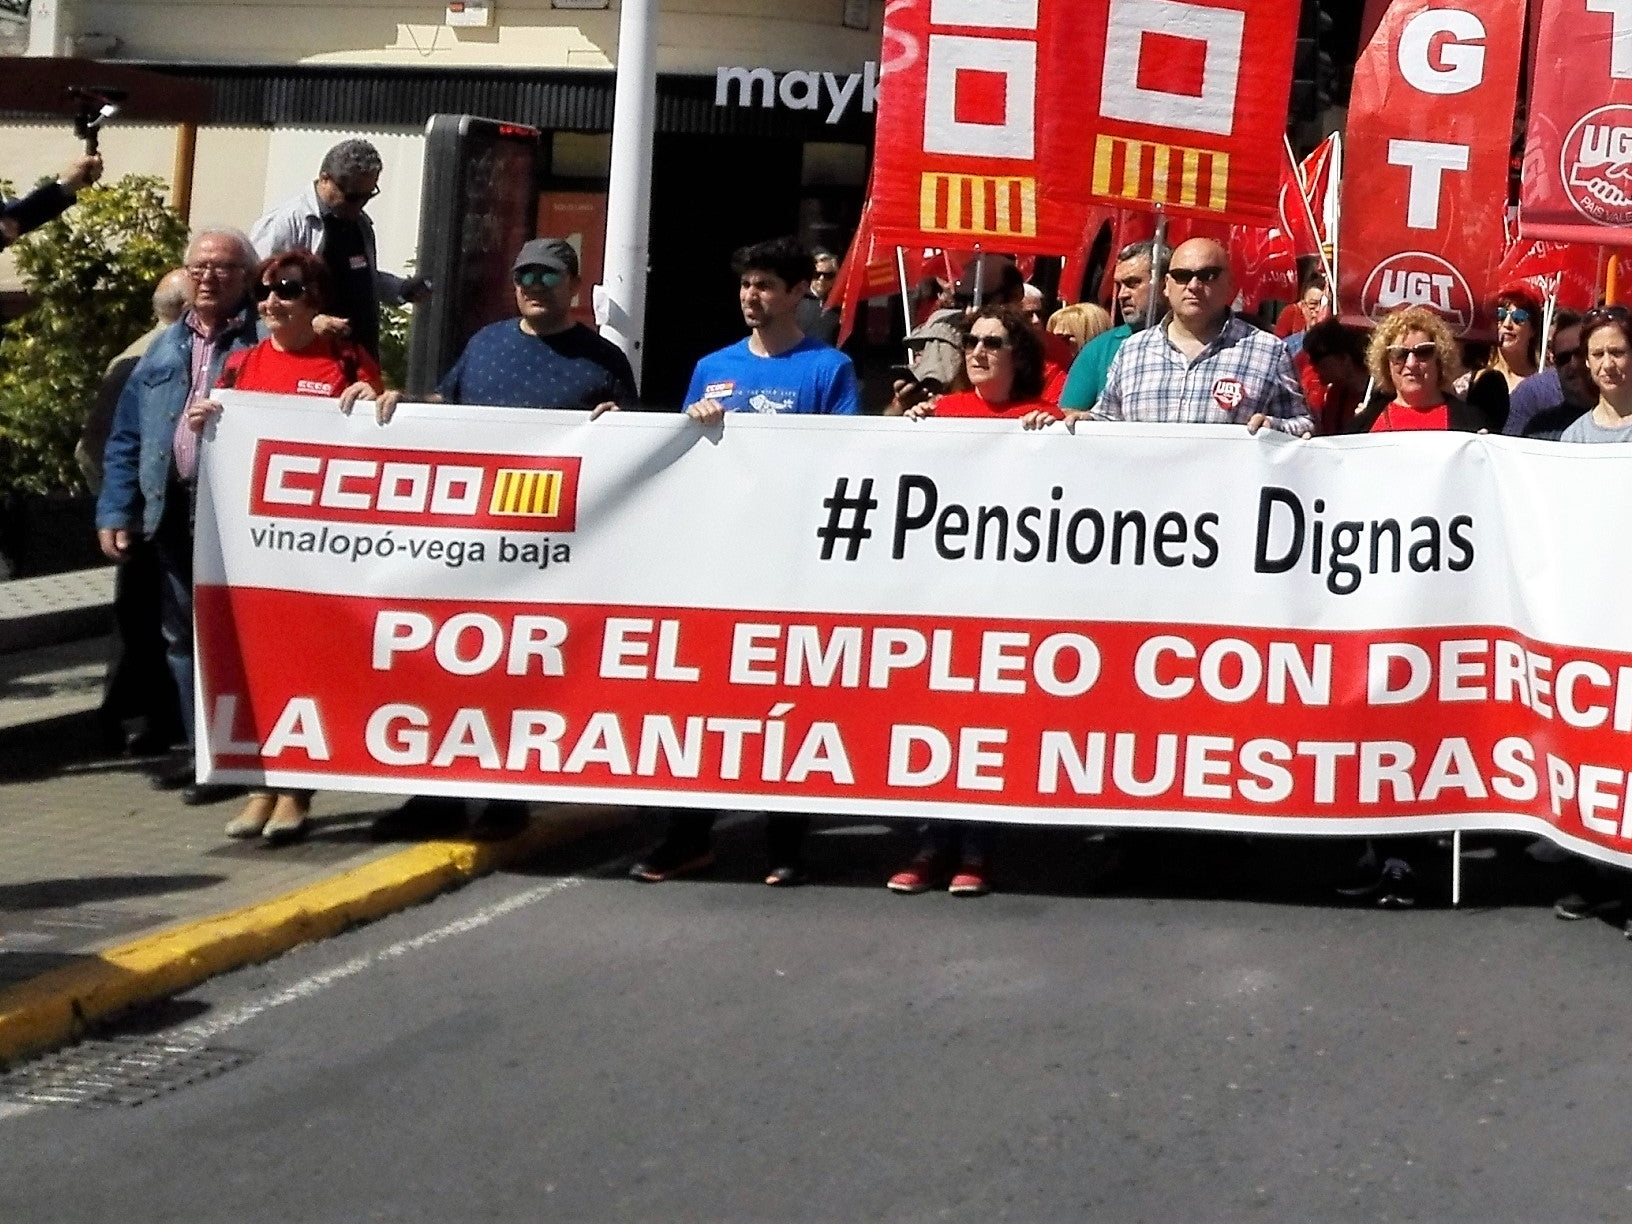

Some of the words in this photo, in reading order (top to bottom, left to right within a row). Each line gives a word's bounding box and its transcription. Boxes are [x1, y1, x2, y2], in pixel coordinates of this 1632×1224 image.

[1378, 269, 1455, 312] UGT
[262, 454, 484, 516] CCOO
[250, 522, 486, 569] vinalopó-vega
[498, 535, 572, 571] baja
[1254, 485, 1475, 596] Dignas
[371, 610, 570, 678] POR
[599, 617, 700, 682] EL
[728, 622, 1102, 698] EMPLEO
[1133, 634, 1331, 706] CON
[208, 693, 331, 762] LA
[364, 702, 855, 787] GARANTÍA
[886, 725, 1009, 793] DE
[1037, 729, 1538, 806] NUESTRAS
